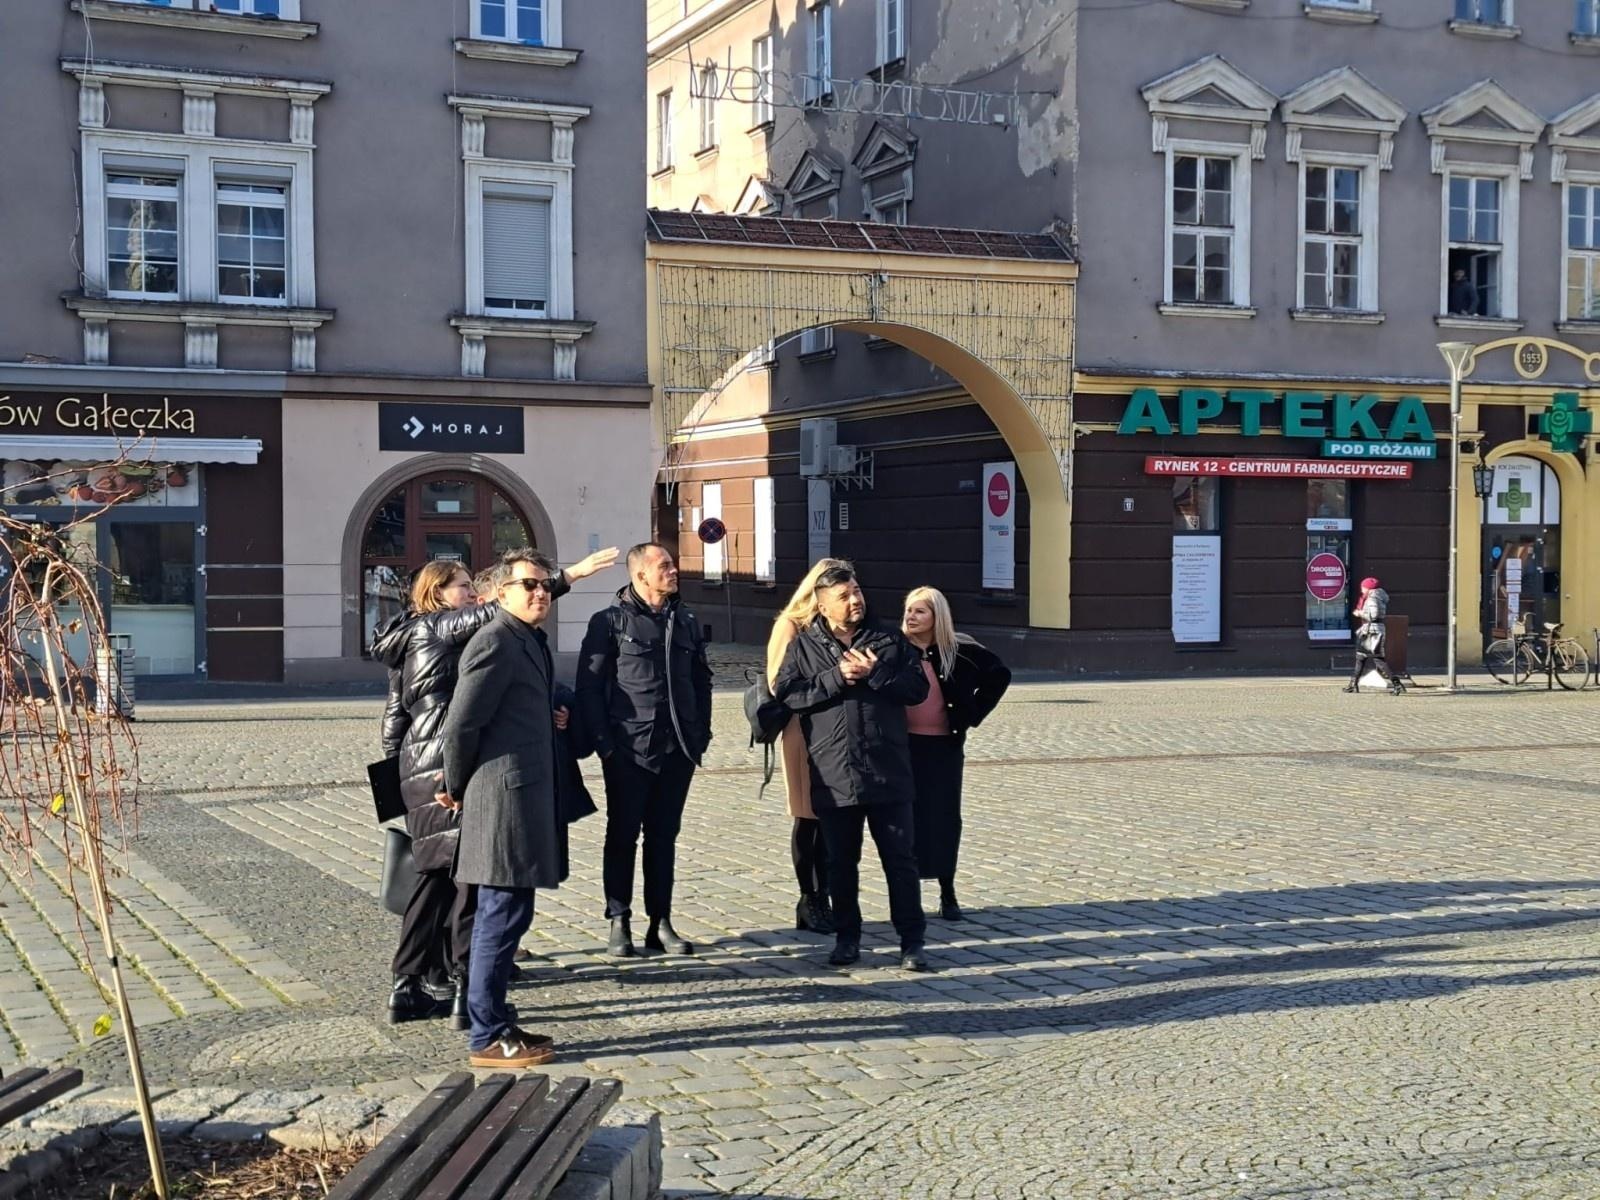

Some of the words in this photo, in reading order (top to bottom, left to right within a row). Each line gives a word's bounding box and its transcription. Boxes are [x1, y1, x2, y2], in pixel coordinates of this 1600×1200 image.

[1522, 353, 1541, 364] 1953
[55, 392, 196, 434] Gałeczka
[1116, 387, 1436, 440] APTEKA
[432, 423, 503, 436] MORAJ
[1330, 443, 1364, 455] POD
[1369, 441, 1432, 456] RÓŻAMI
[1154, 460, 1200, 472] RYNEK
[1203, 461, 1218, 473] 12
[1229, 461, 1291, 474] CENTRUM
[1294, 462, 1408, 476] FARMACEUTYCZNE
